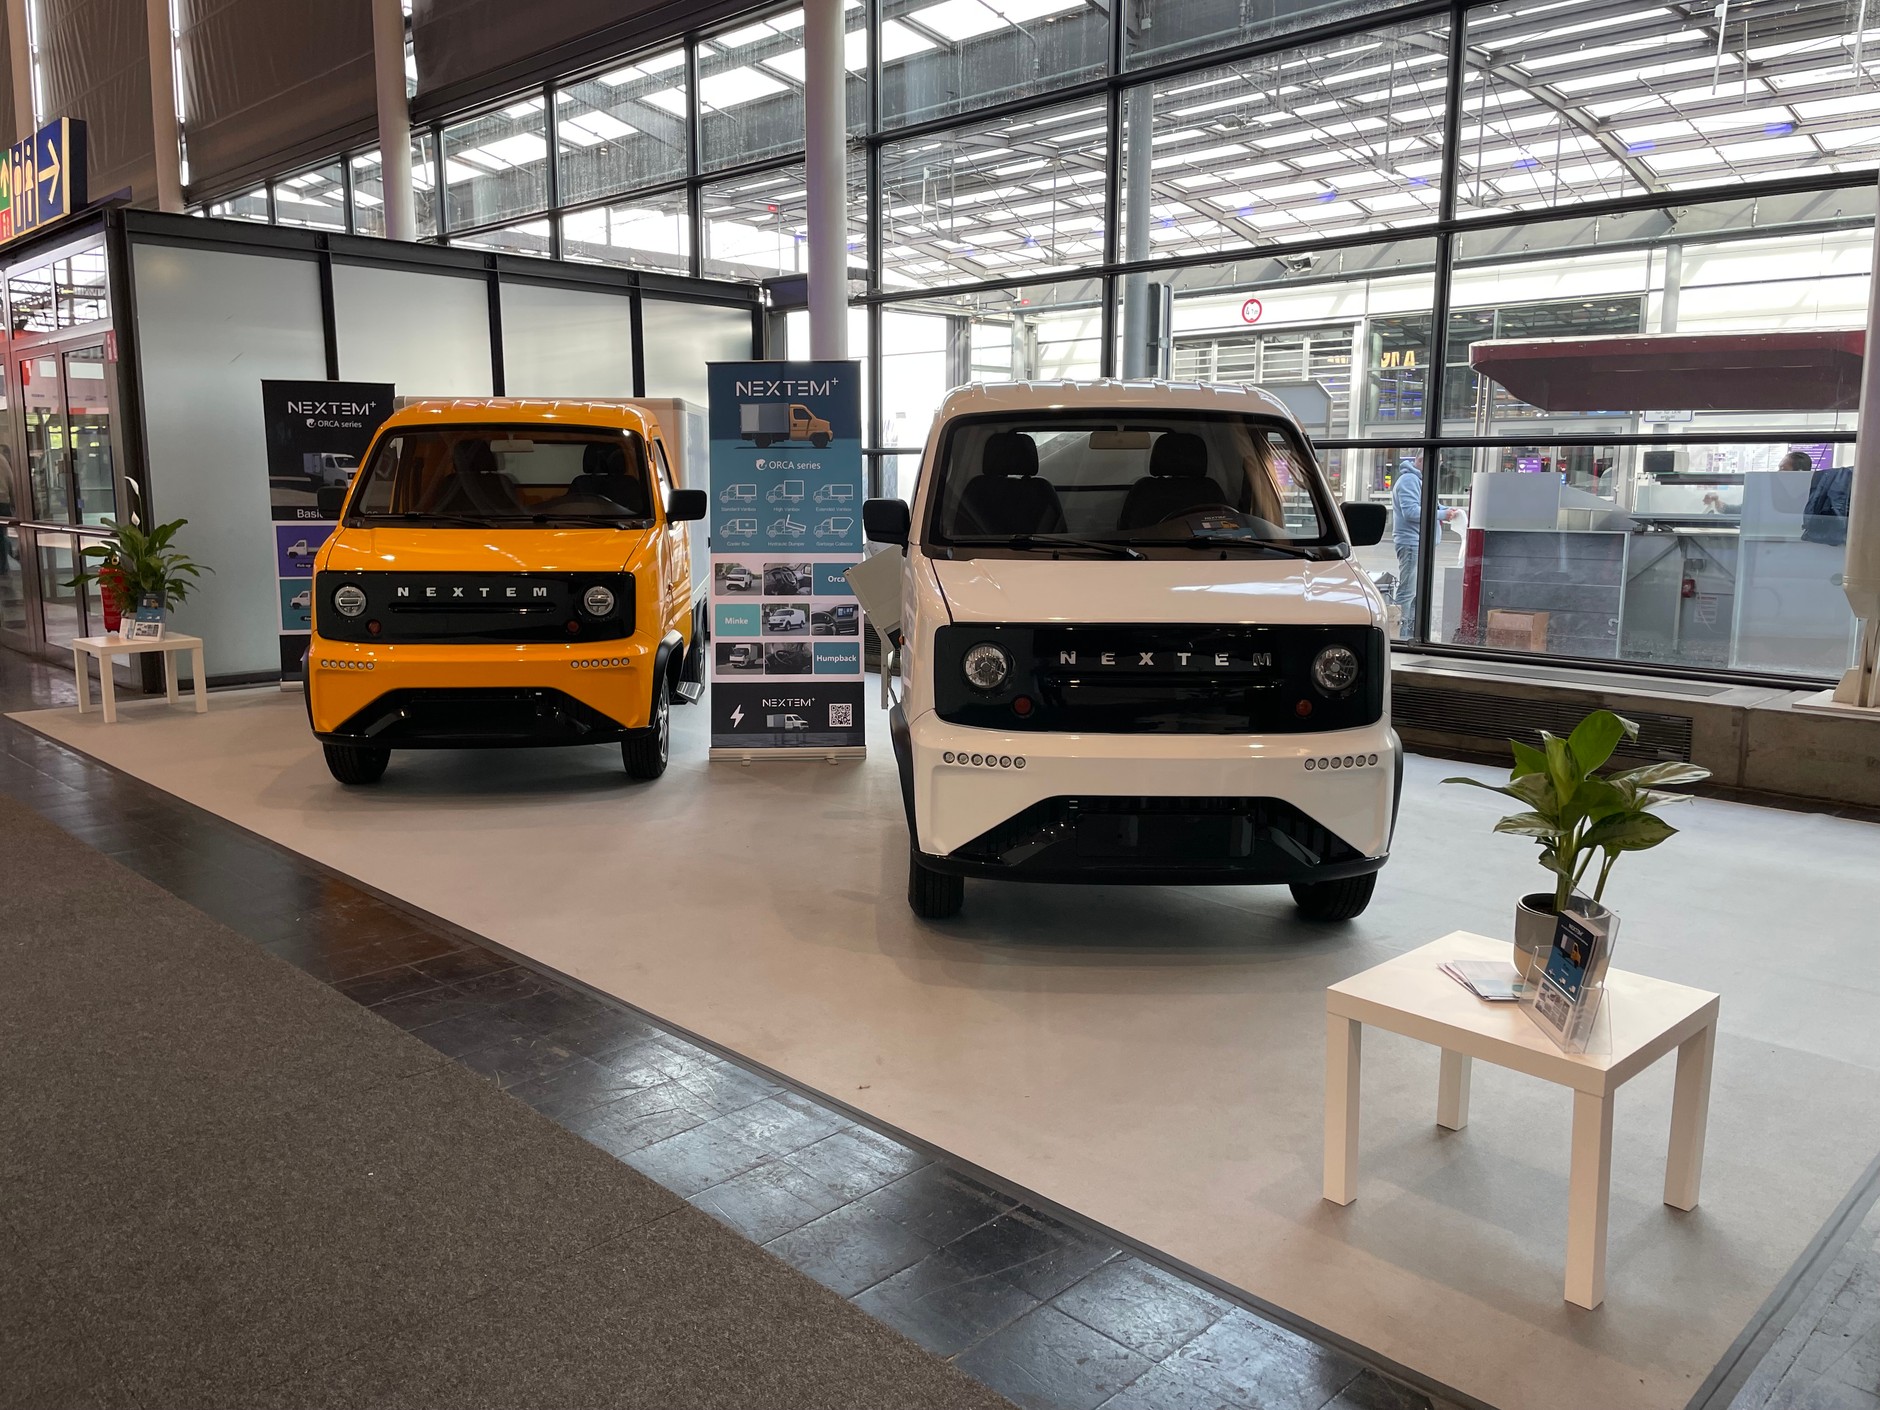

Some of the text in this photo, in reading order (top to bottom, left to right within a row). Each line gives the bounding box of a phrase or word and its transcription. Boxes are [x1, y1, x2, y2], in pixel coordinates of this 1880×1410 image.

[317, 420, 362, 428] ORCA series
[768, 461, 821, 470] ORCA series
[827, 575, 845, 583] Orca
[397, 587, 547, 597] NEXTEM
[724, 617, 748, 625] Minke
[816, 654, 857, 663] Humpback
[1060, 650, 1272, 667] NEXTEM
